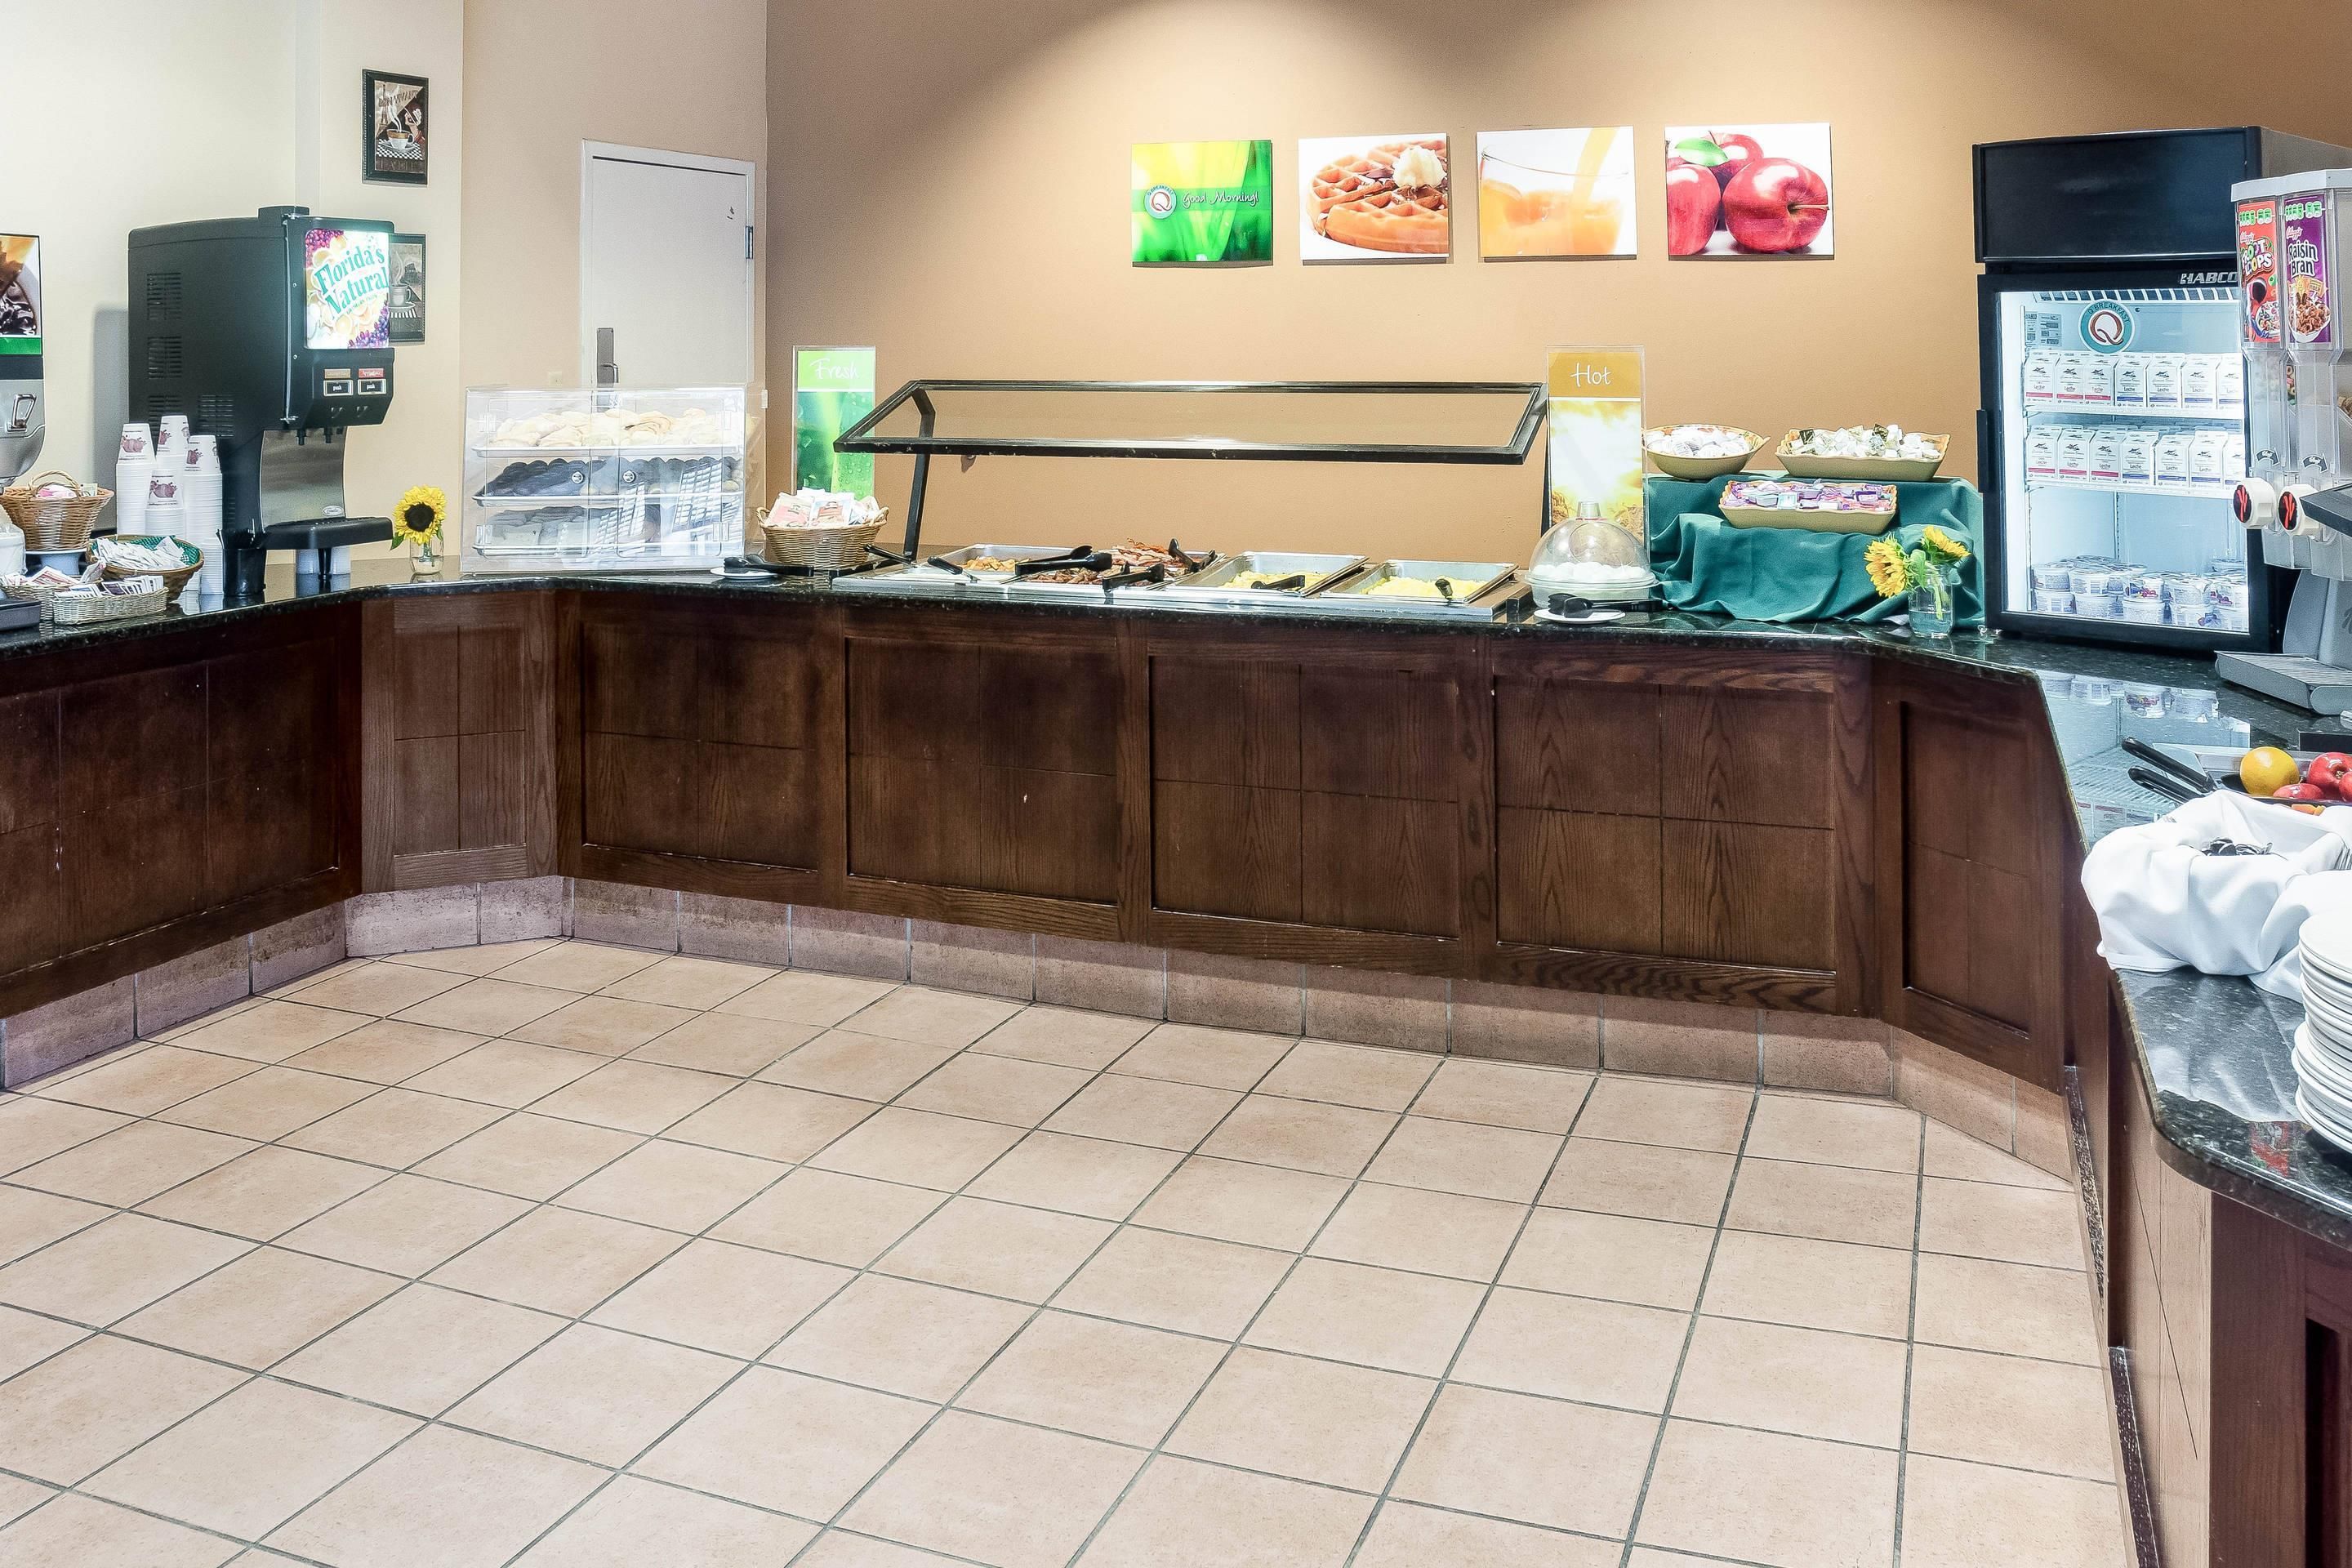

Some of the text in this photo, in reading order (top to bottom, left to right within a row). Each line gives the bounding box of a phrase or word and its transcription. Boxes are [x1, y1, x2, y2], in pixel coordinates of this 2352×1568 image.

[1183, 189, 1259, 209] Good Morning!
[2288, 239, 2319, 261] Raisin
[314, 245, 385, 296] Florida's
[2180, 271, 2238, 284] HABCO
[2291, 260, 2315, 278] Bran
[324, 267, 390, 322] Natural
[2094, 301, 2131, 323] BREAKFAST
[809, 358, 860, 380] Fresh
[1570, 362, 1611, 388] Hot
